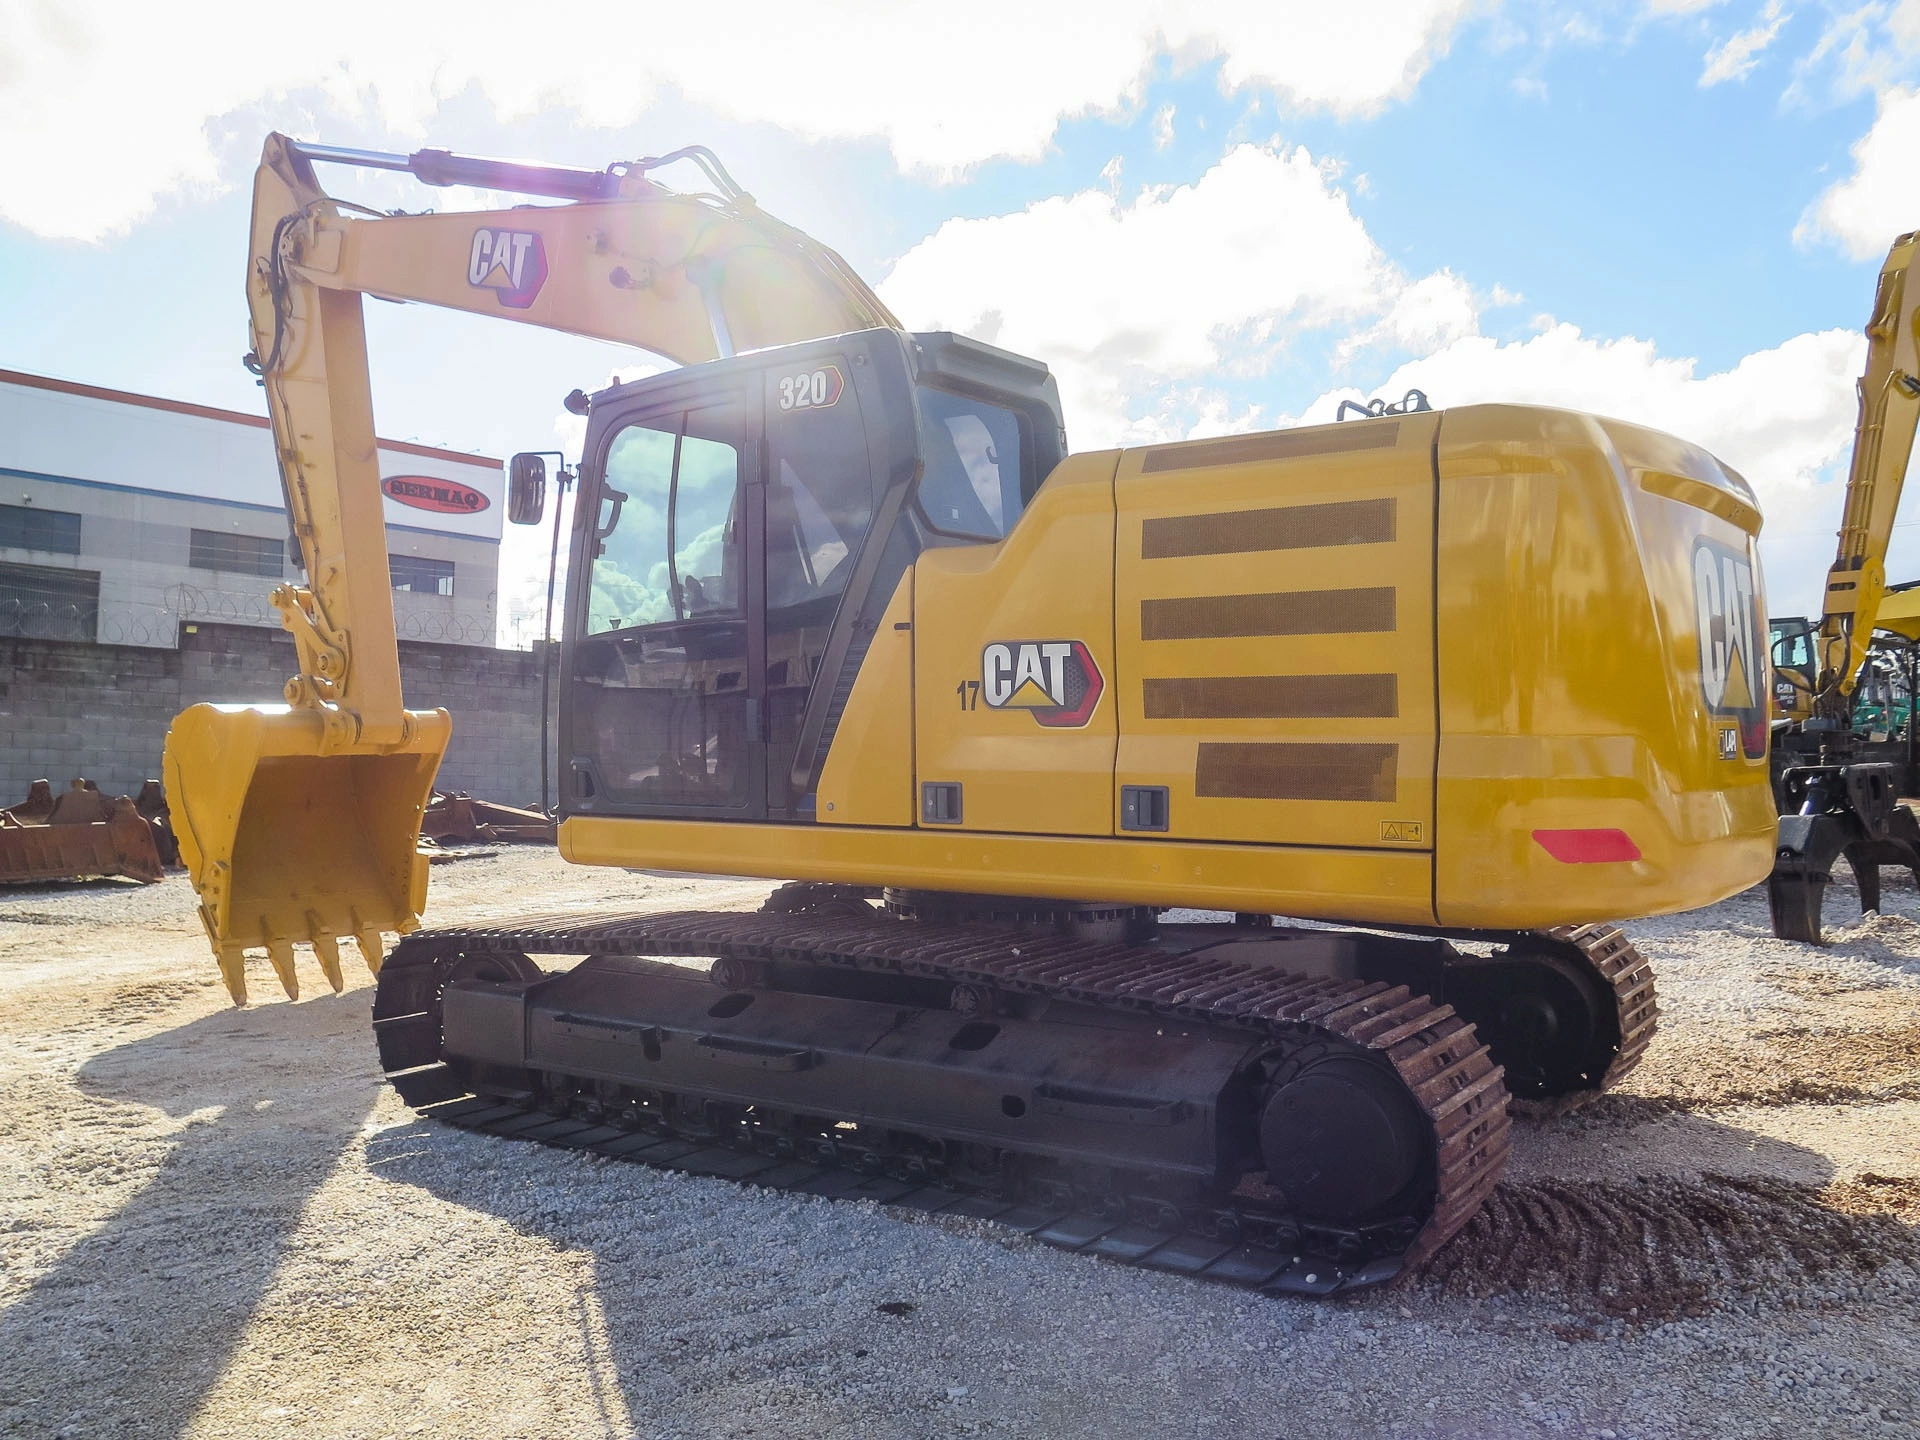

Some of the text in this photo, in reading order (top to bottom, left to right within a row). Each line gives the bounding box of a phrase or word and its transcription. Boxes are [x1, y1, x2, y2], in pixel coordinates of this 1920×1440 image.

[469, 229, 533, 289] CAT
[780, 370, 827, 409] 320
[391, 480, 479, 509] SERMAQ
[1695, 547, 1757, 708] CAT
[956, 680, 980, 711] 17
[983, 643, 1071, 707] CAT
